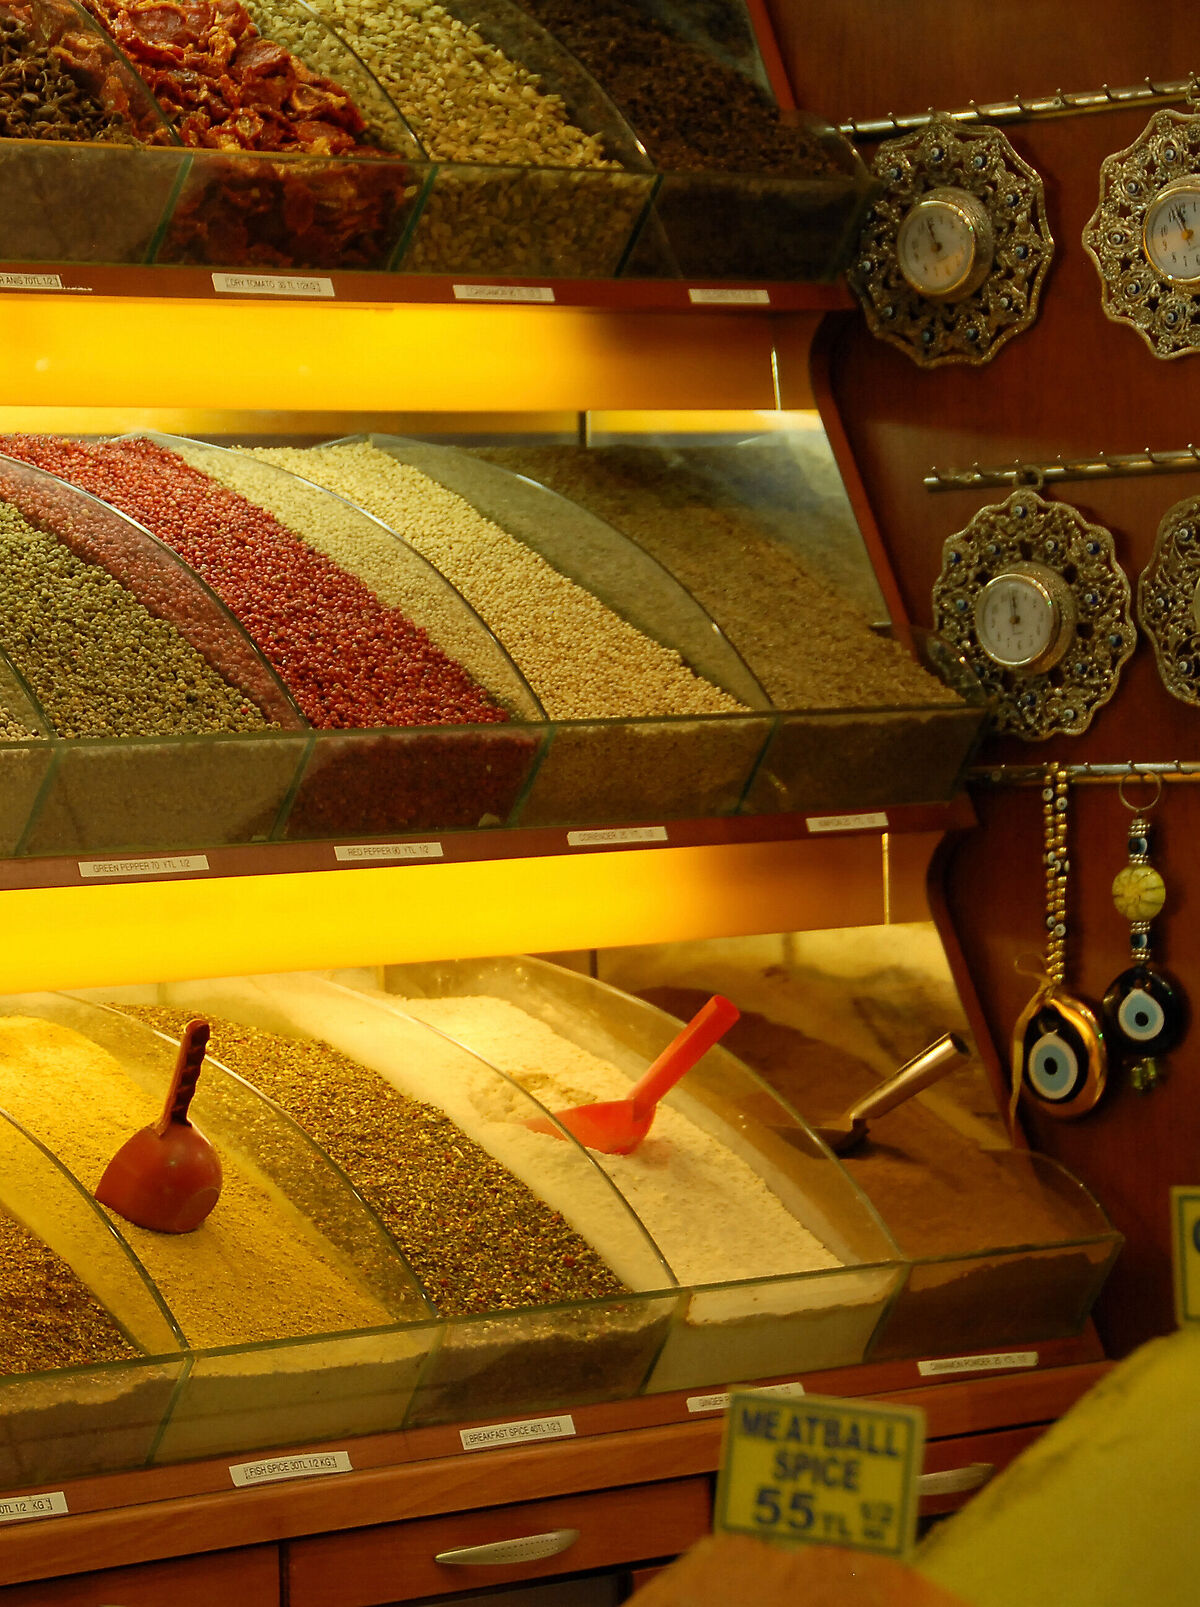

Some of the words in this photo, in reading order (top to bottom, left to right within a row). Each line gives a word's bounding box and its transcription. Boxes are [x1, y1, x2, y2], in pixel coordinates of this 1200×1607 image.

[230, 278, 245, 287] DRY
[247, 279, 275, 288] TOMATO
[347, 848, 363, 857] RED
[363, 846, 392, 856] PEPPER
[92, 863, 119, 873] GREEN
[120, 862, 149, 872] PEPPER
[150, 860, 160, 870] 70
[179, 858, 190, 868] 1/2
[469, 1429, 508, 1443] BREAKFAST
[508, 1426, 529, 1437] SPICE
[742, 1408, 899, 1457] MEATBALL
[249, 1465, 267, 1476] FISH
[267, 1462, 289, 1474] SPICE
[290, 1460, 308, 1470] 30TL
[308, 1458, 319, 1468] 1/2
[320, 1457, 331, 1467] KG
[773, 1450, 860, 1491] SPICE
[15, 1502, 26, 1512] 1/2
[32, 1500, 44, 1510] KG
[755, 1488, 815, 1530] 55
